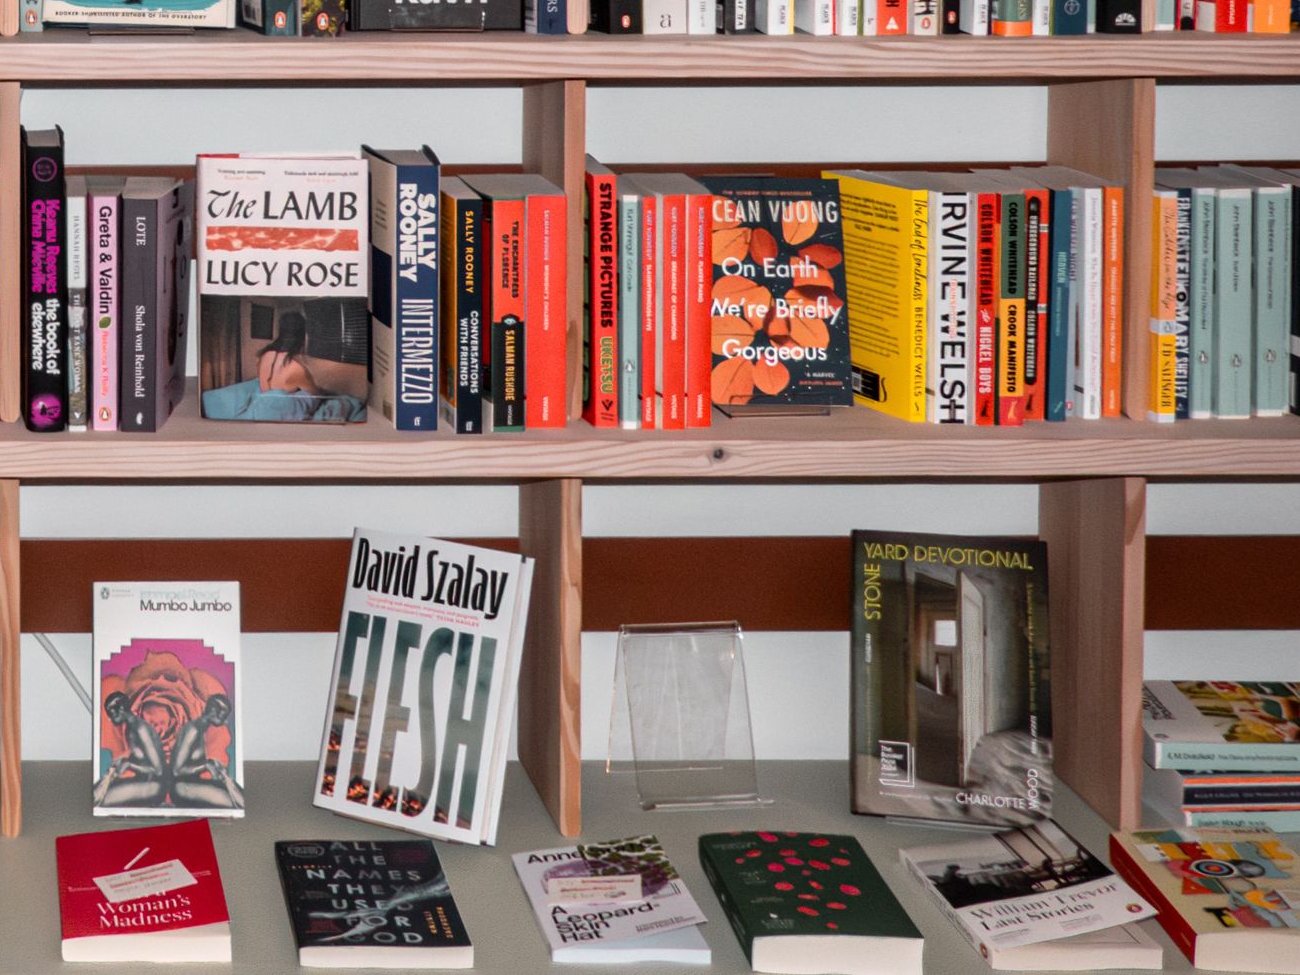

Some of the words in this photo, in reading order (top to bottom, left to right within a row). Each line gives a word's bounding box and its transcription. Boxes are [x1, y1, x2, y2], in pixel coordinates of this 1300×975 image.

[205, 189, 256, 220] The
[262, 191, 358, 221] LAMB
[600, 182, 612, 255] STRANGE
[712, 199, 761, 223] CEAN
[771, 200, 838, 224] VUONG
[99, 206, 113, 247] Greta
[400, 183, 418, 283] ROONEY
[417, 192, 436, 270] SALLY
[99, 254, 112, 263] &
[940, 192, 967, 301] IRVINE
[206, 261, 278, 287] LUCY
[287, 261, 359, 287] ROSE
[722, 256, 756, 279] On
[763, 258, 818, 279] Earth
[99, 267, 110, 315] Valdin
[600, 259, 613, 328] PICTURES
[711, 297, 767, 318] We're
[776, 298, 843, 325] Briefly
[401, 298, 434, 404] INTERMEZZO
[600, 336, 613, 394] UKETSU
[722, 339, 828, 367] Gorgeous
[939, 310, 967, 425] WELSH
[863, 542, 909, 561] YARD
[914, 544, 1034, 570] DEVOTIONAL
[352, 537, 420, 599] David
[421, 549, 509, 621] Szalay
[864, 563, 881, 621] STONE
[140, 599, 188, 612] Mumbo
[188, 600, 232, 612] Jumbo
[321, 610, 498, 830] FLESH
[955, 792, 1026, 810] CHARLOTTE
[1027, 768, 1038, 810] WOOD
[96, 894, 191, 915] Woman's
[551, 905, 568, 915] A
[970, 894, 1051, 921] William
[1054, 882, 1117, 904] Trevor
[980, 913, 1025, 931] Last
[1028, 901, 1095, 924] Stories
[99, 910, 193, 929] Madness
[556, 921, 610, 934] Skin
[560, 929, 604, 943] Hat
